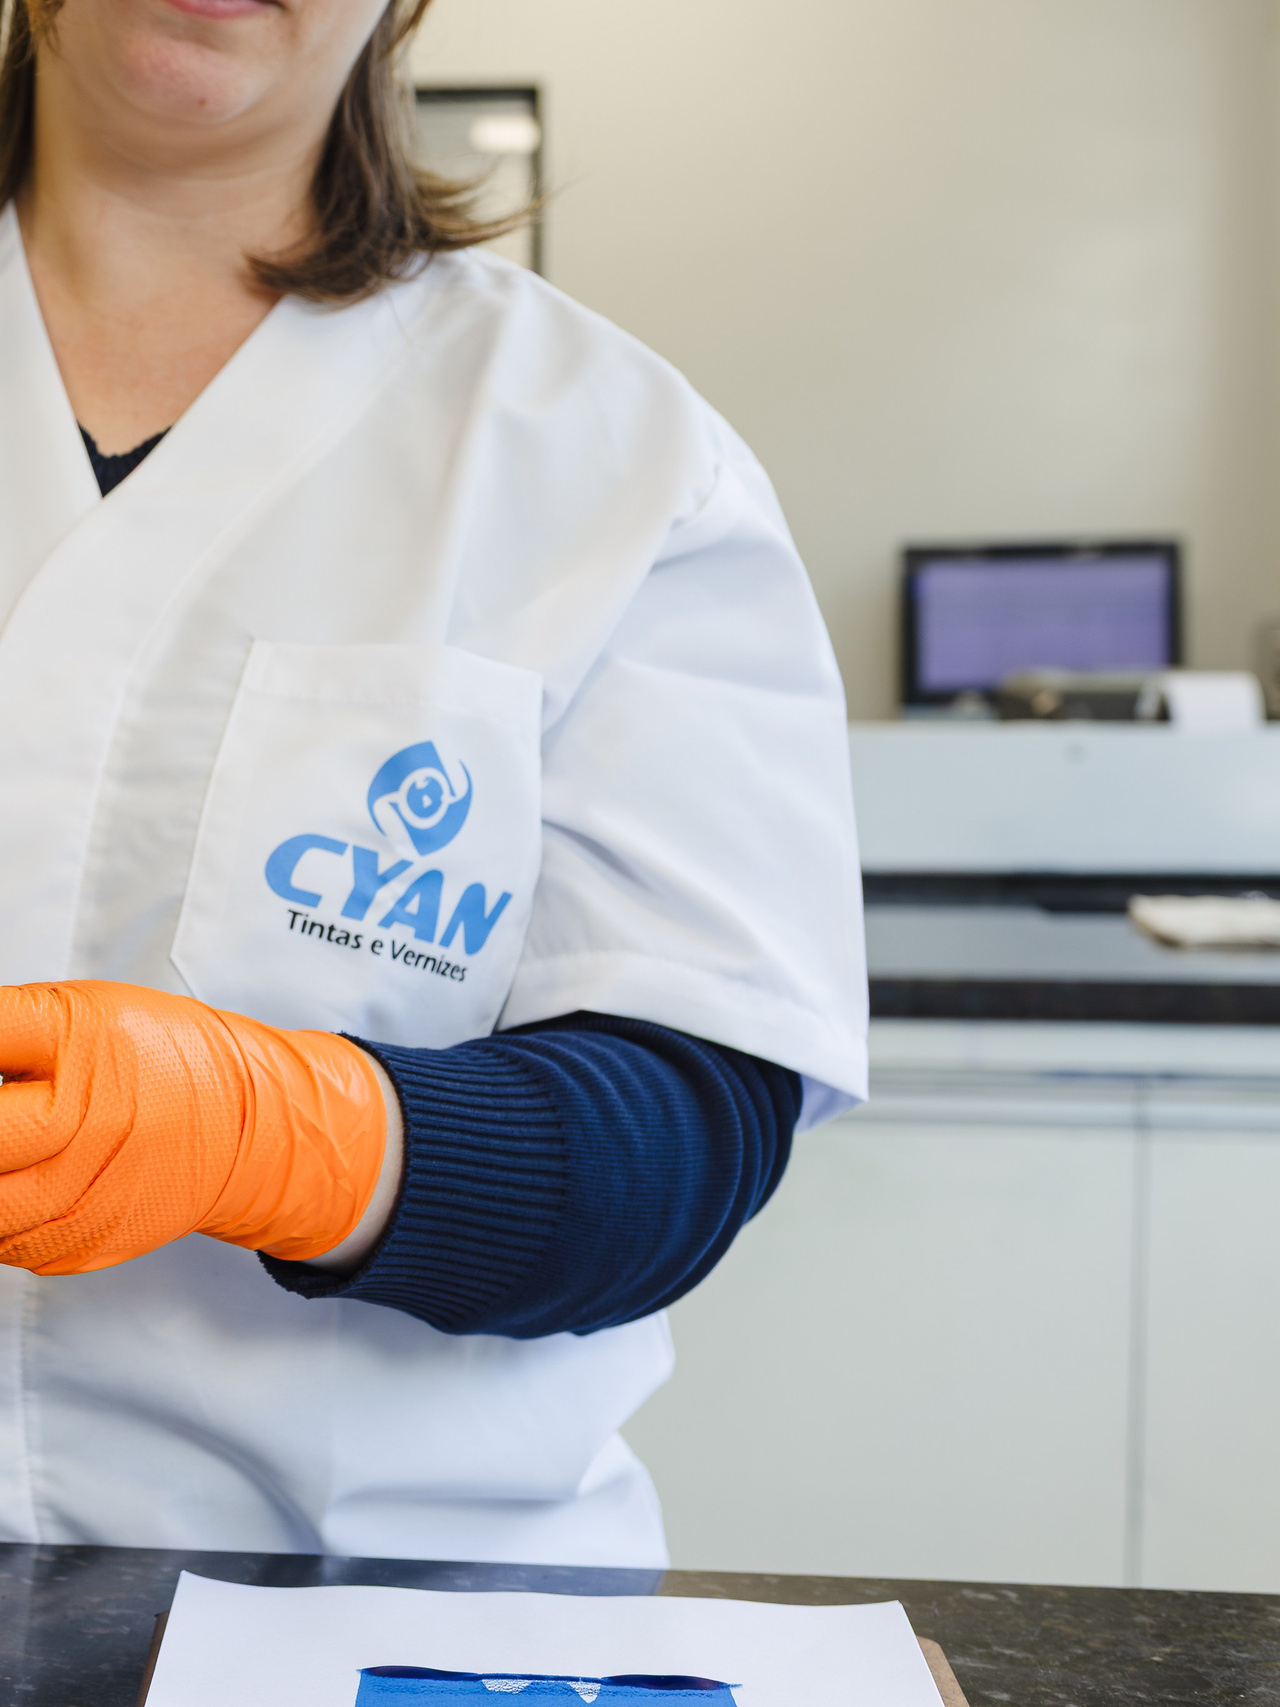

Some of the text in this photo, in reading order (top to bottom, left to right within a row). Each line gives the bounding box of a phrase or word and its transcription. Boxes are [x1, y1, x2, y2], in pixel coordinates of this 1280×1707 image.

[265, 834, 512, 955] CYAN
[288, 909, 467, 982] Tintas e Vernizes
